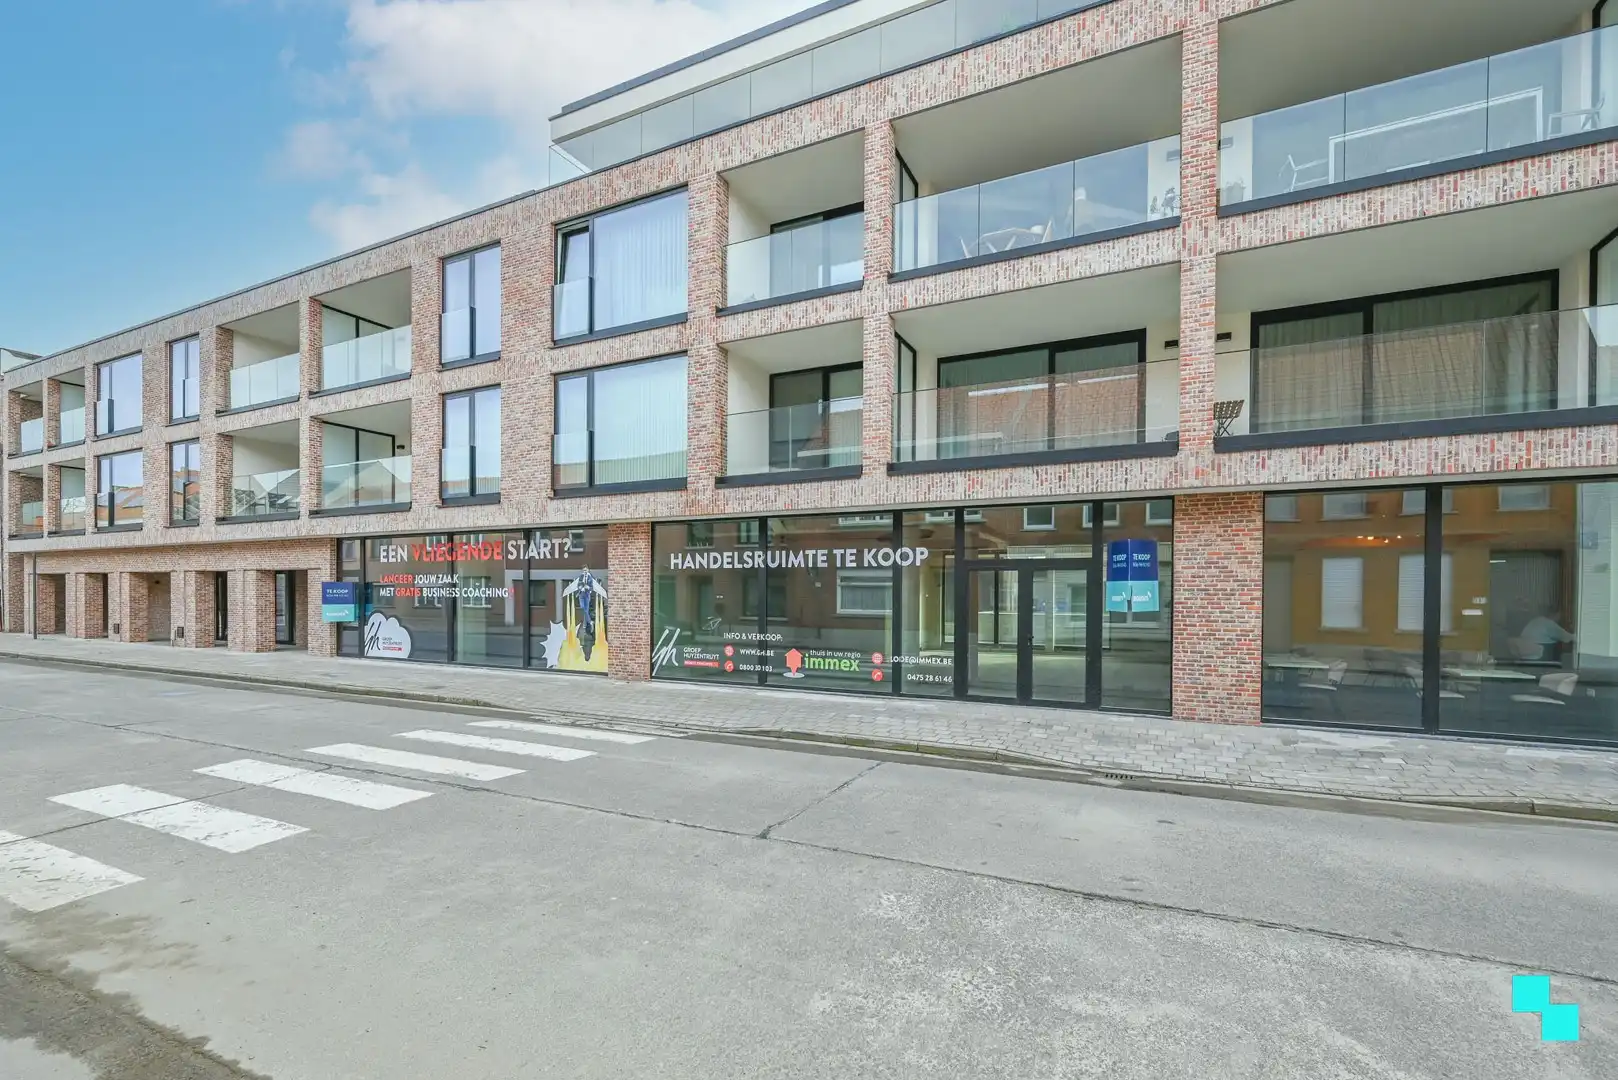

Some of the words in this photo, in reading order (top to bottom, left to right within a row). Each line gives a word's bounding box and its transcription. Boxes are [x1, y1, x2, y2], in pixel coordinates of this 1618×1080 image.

[380, 544, 408, 563] EEN
[411, 540, 504, 562] VLIEGENDE
[507, 537, 571, 560] START?
[670, 550, 828, 570] HANDELSRUIMTE
[833, 548, 857, 568] TE
[863, 546, 929, 567] KOOP
[380, 573, 413, 584] LANCEER
[414, 573, 437, 584] JOUW
[438, 573, 459, 584] ZAAK
[379, 587, 395, 597] MET
[395, 587, 421, 597] GRATIS
[422, 587, 461, 598] BUSINESS
[723, 632, 741, 640] INFO
[844, 651, 861, 659] regio
[804, 653, 860, 672] immex
[907, 673, 924, 681] 0475
[925, 674, 934, 682] 28
[943, 675, 953, 683] 46
